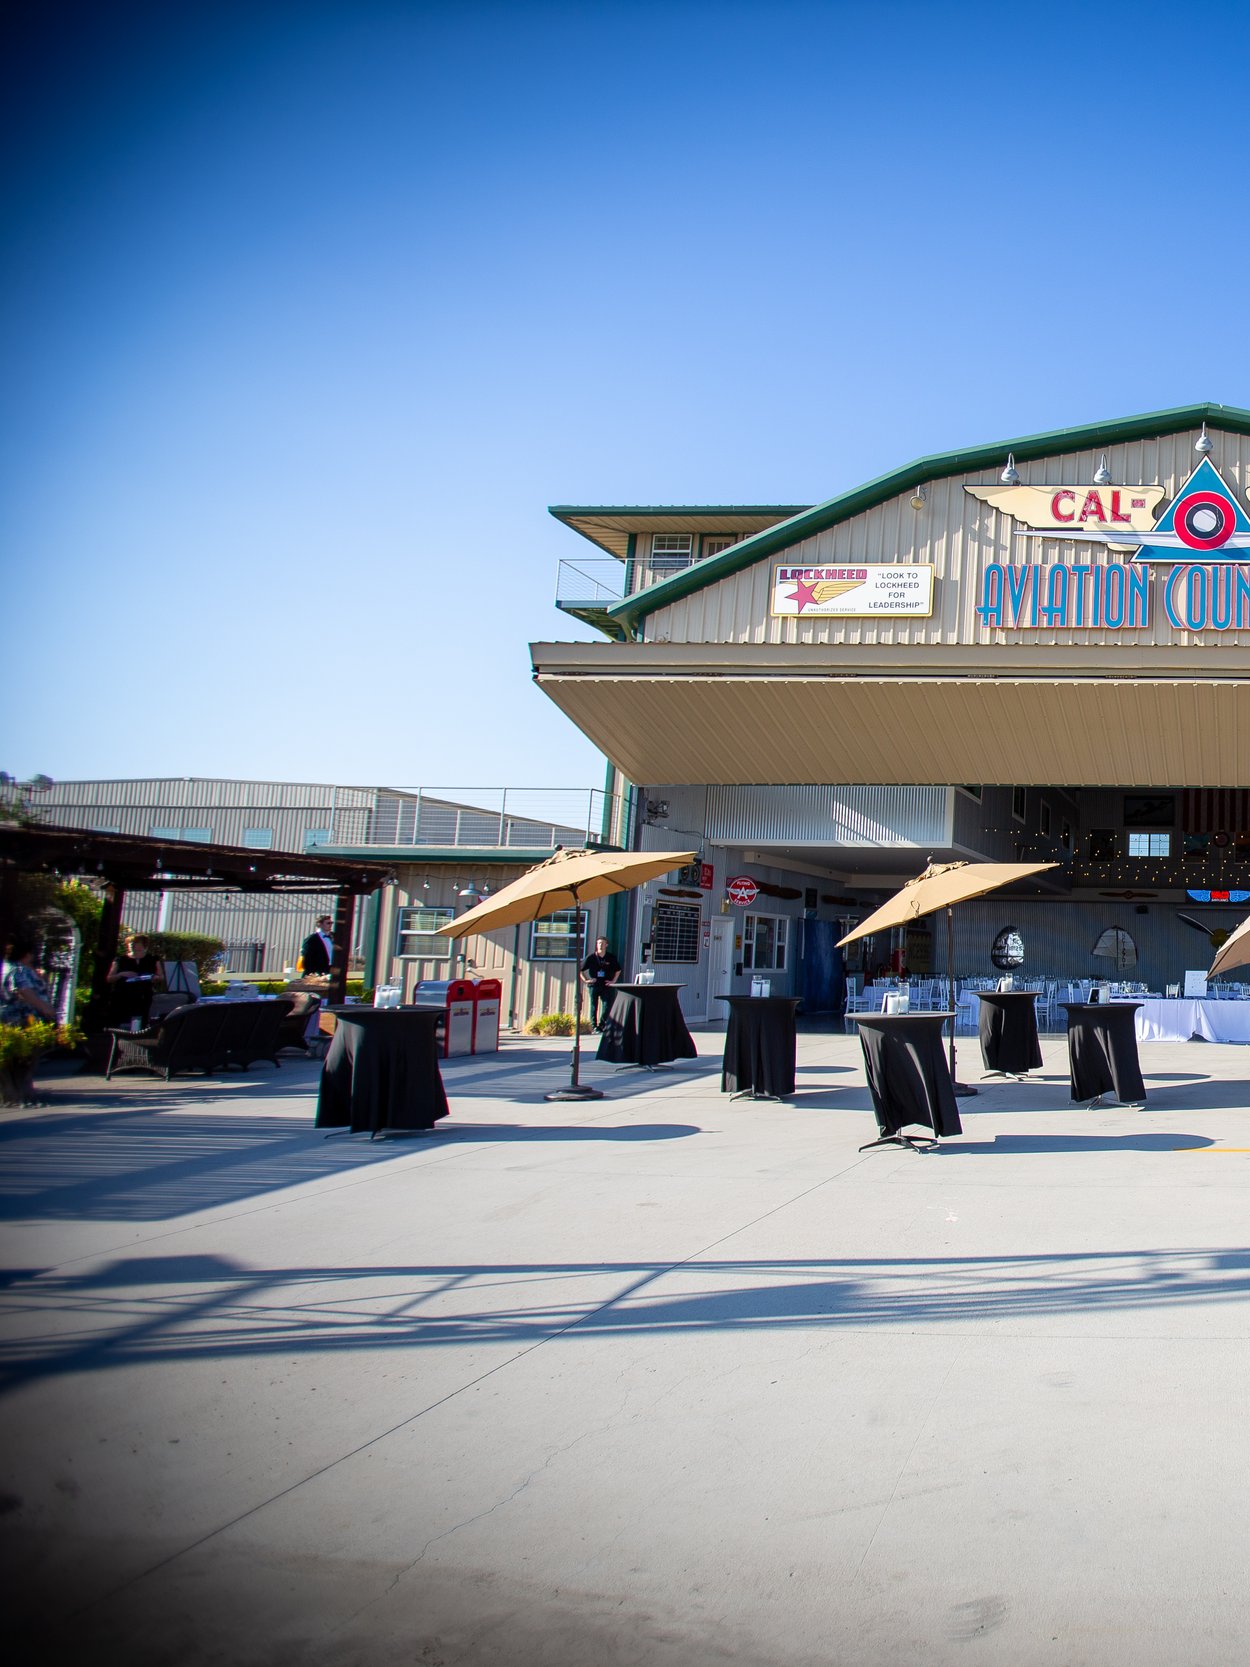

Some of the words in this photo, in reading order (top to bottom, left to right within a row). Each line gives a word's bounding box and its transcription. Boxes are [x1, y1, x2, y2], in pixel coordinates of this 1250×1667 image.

[1050, 489, 1146, 525] CAL-
[779, 569, 868, 580] LOCKHEED
[974, 562, 1150, 629] AVIATION
